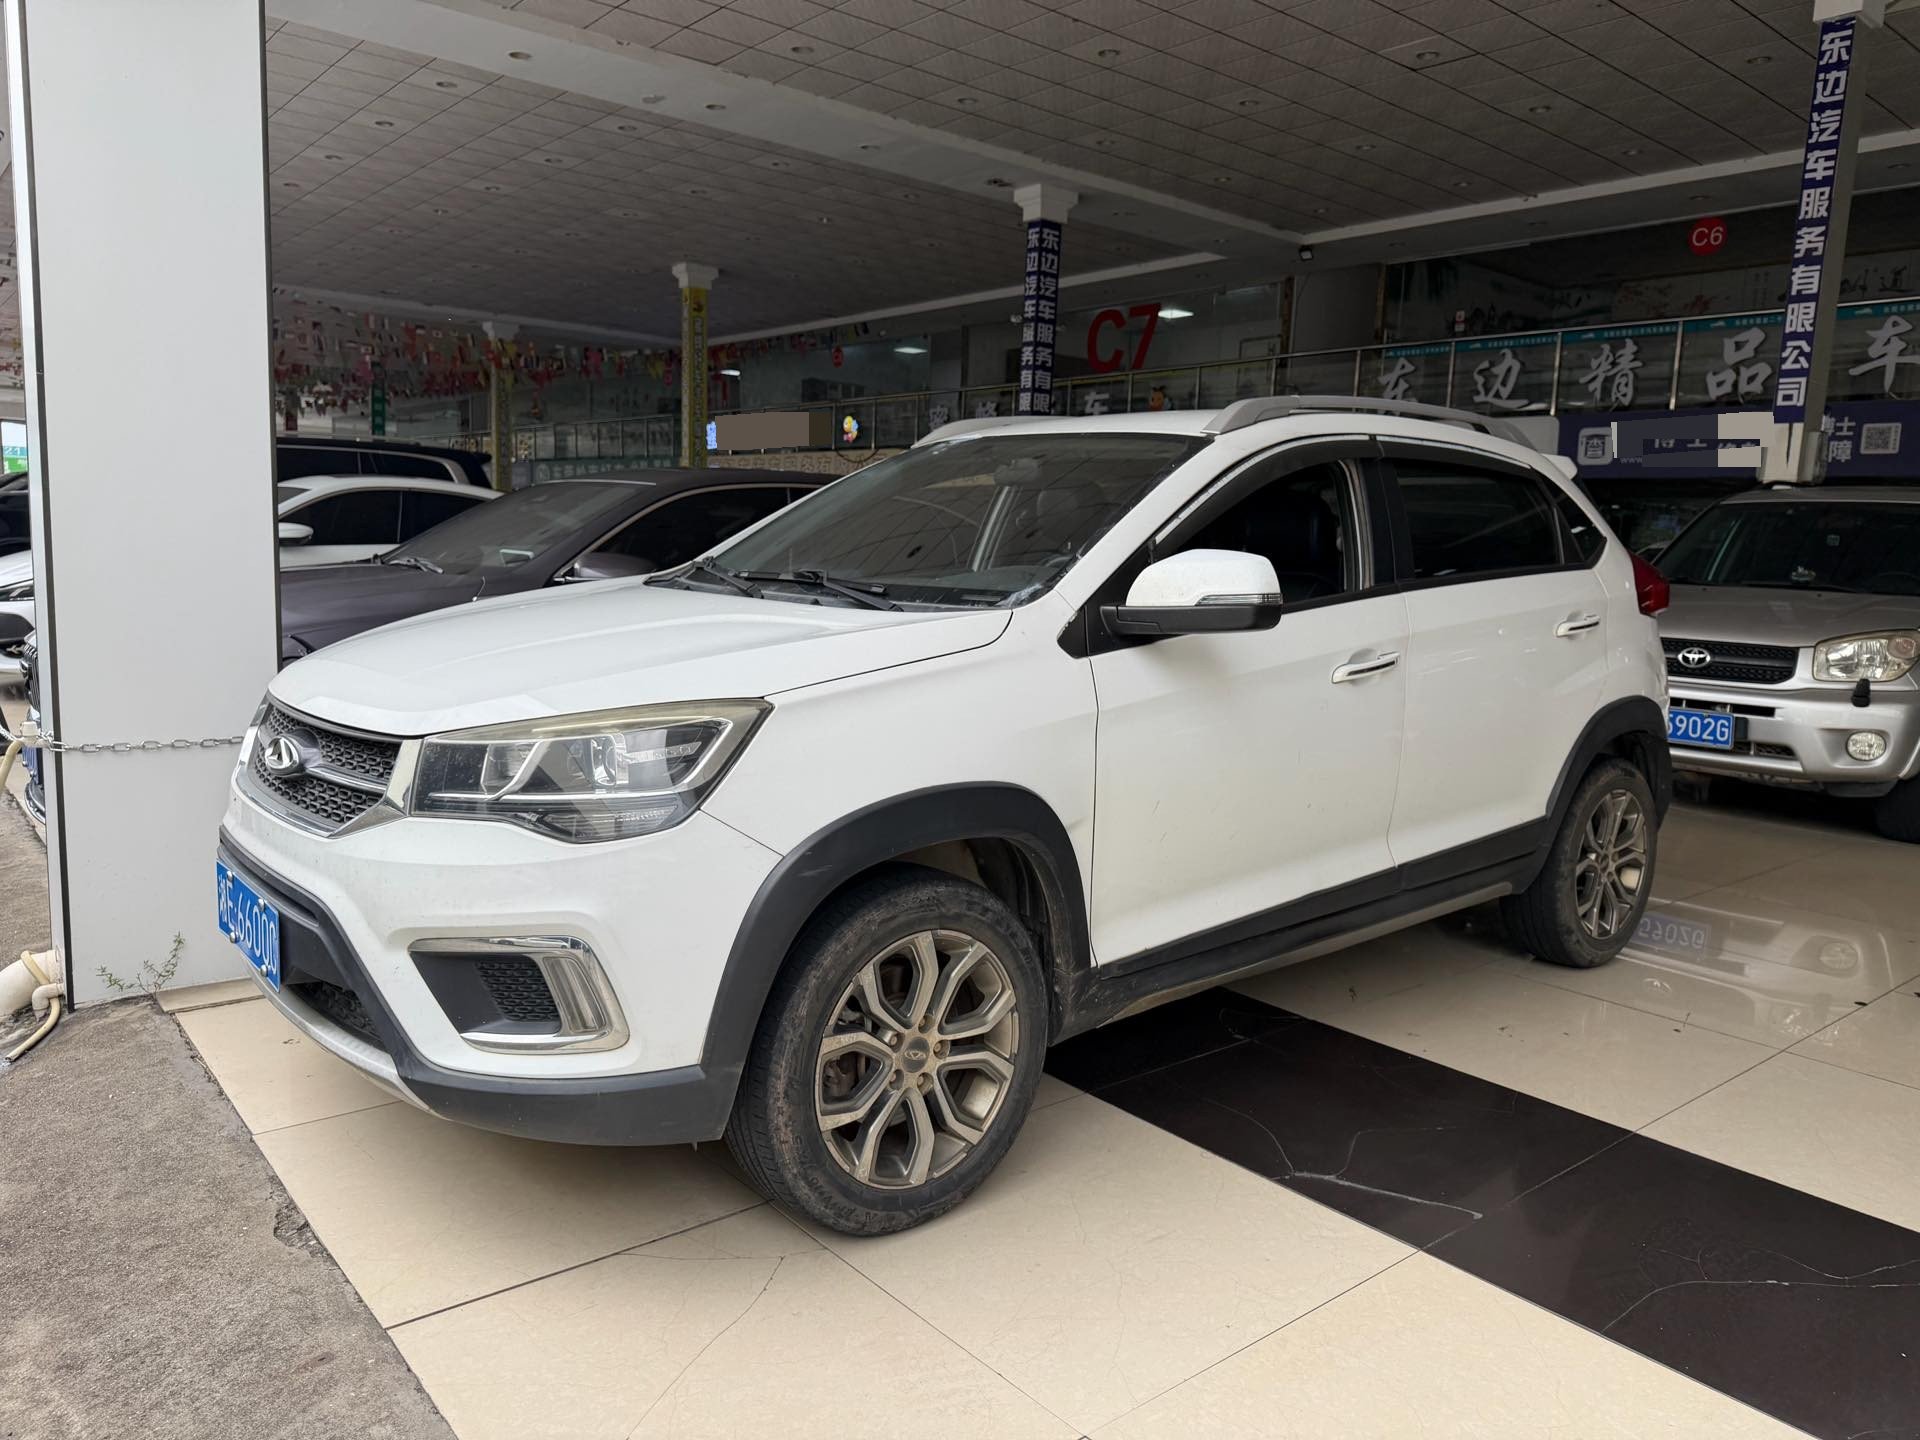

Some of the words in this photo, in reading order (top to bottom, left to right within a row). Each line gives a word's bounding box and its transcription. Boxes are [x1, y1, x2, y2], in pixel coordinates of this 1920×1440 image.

[1692, 226, 1724, 247] C6
[1776, 30, 1852, 407] 东边汽车服务有限公司
[1087, 302, 1161, 373] C7
